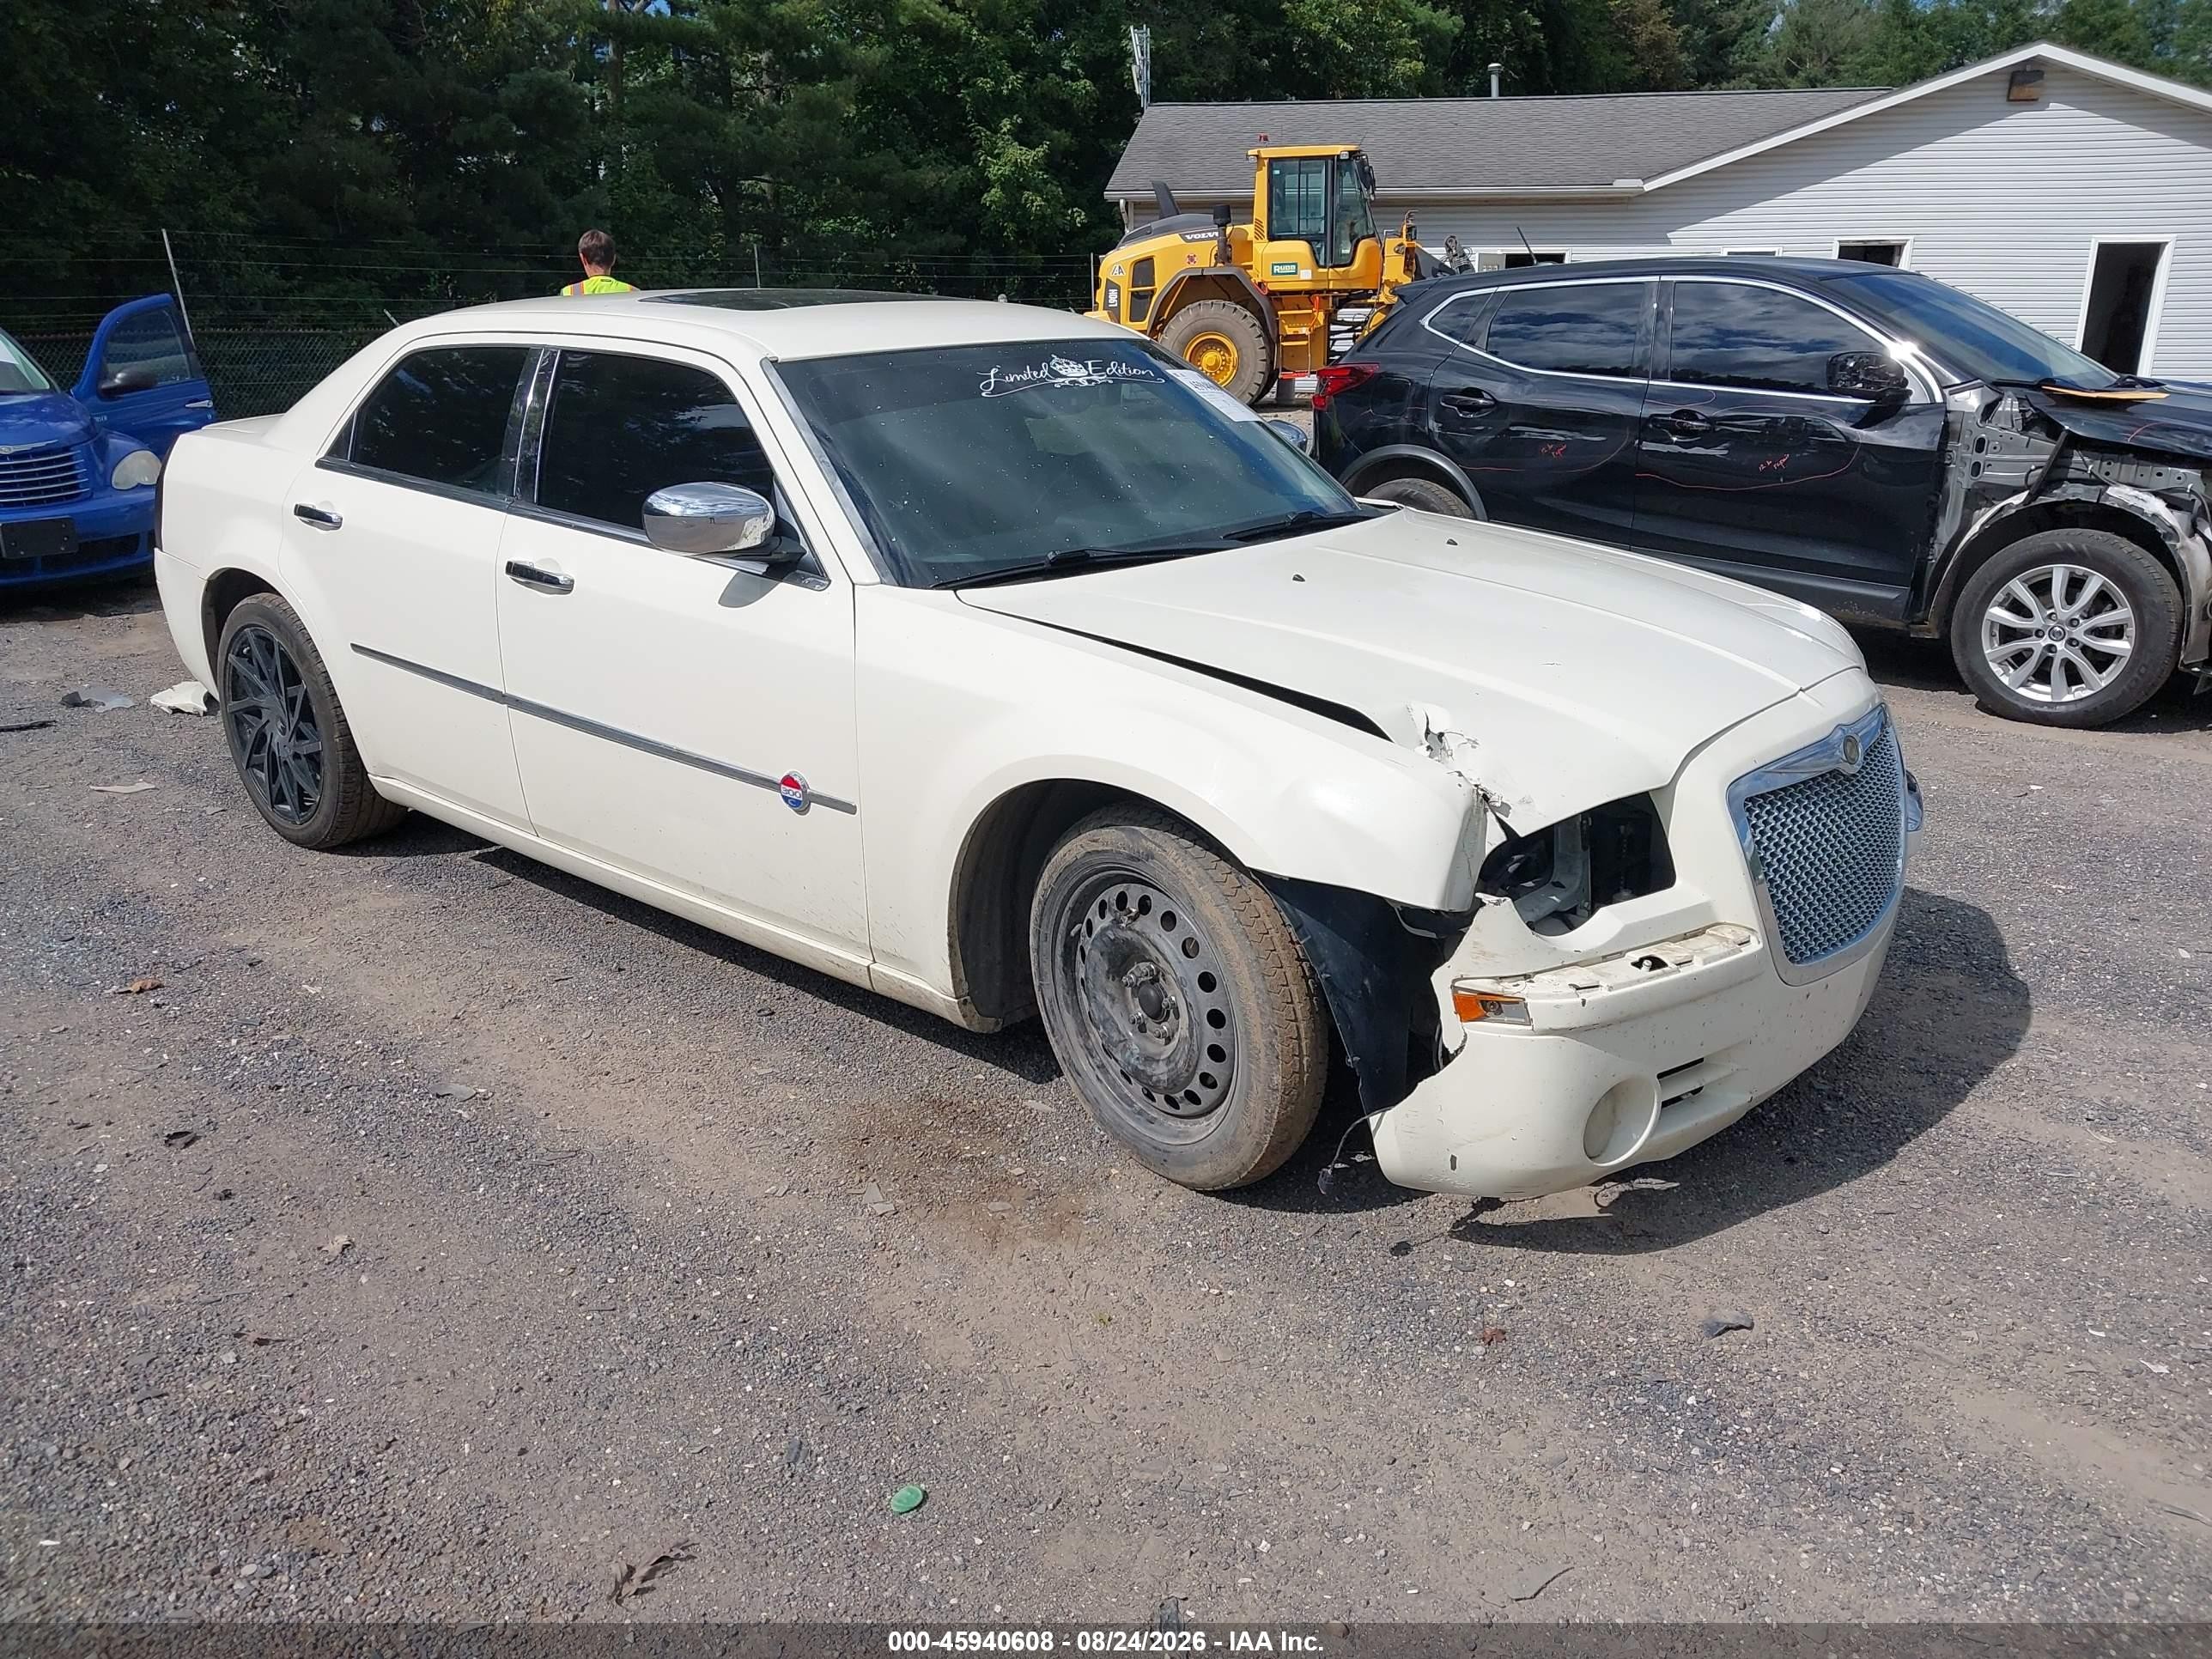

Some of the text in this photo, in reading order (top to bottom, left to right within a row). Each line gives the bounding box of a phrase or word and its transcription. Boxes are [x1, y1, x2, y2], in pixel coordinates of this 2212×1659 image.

[976, 360, 1155, 392] Limited Edition
[782, 787, 802, 799] 300
